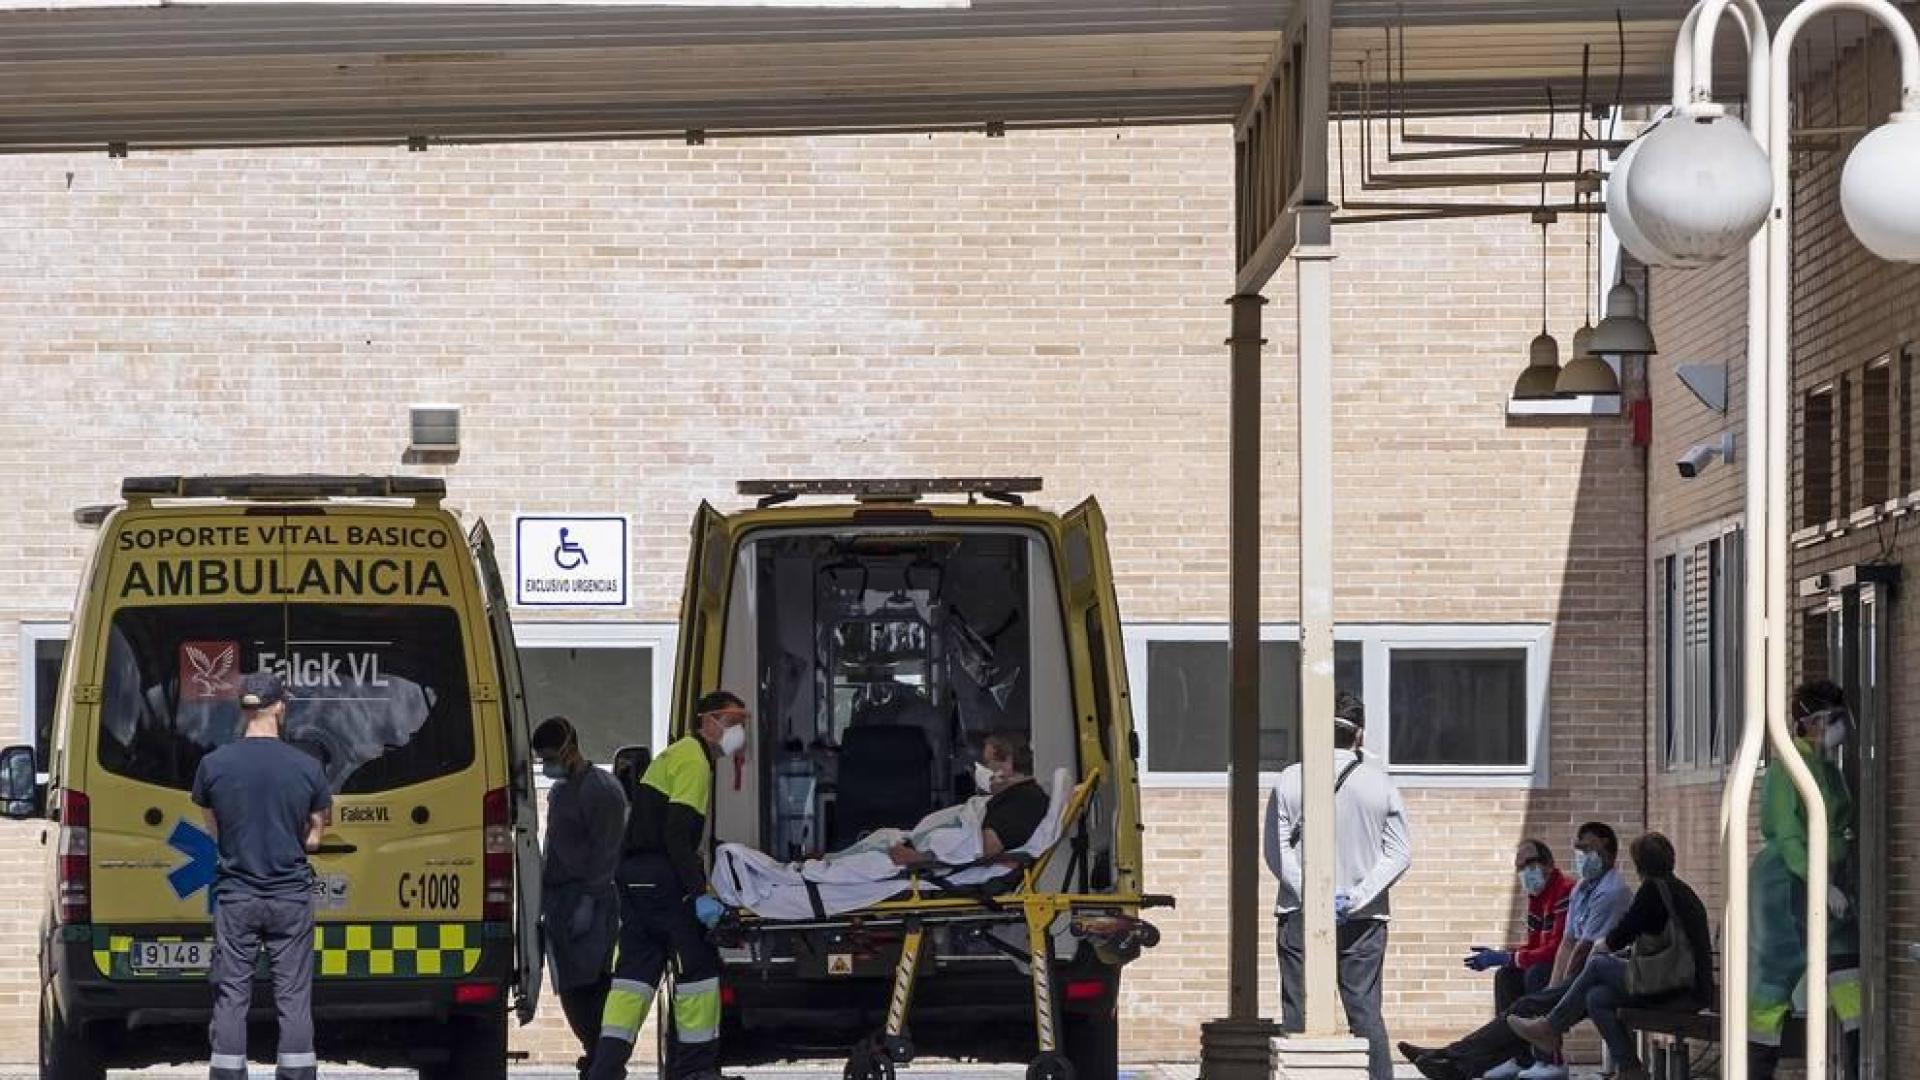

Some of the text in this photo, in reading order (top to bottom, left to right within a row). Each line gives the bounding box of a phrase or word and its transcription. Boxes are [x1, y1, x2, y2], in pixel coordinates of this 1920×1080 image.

[119, 525, 448, 550] SOPORTE VITAL BASICO
[120, 557, 449, 597] AMBULANCIA
[526, 579, 617, 592] EXCLUSIVO URGENCIAS
[258, 652, 389, 687] Falck VL
[341, 806, 389, 821] Falck VL
[146, 945, 199, 965] 9148
